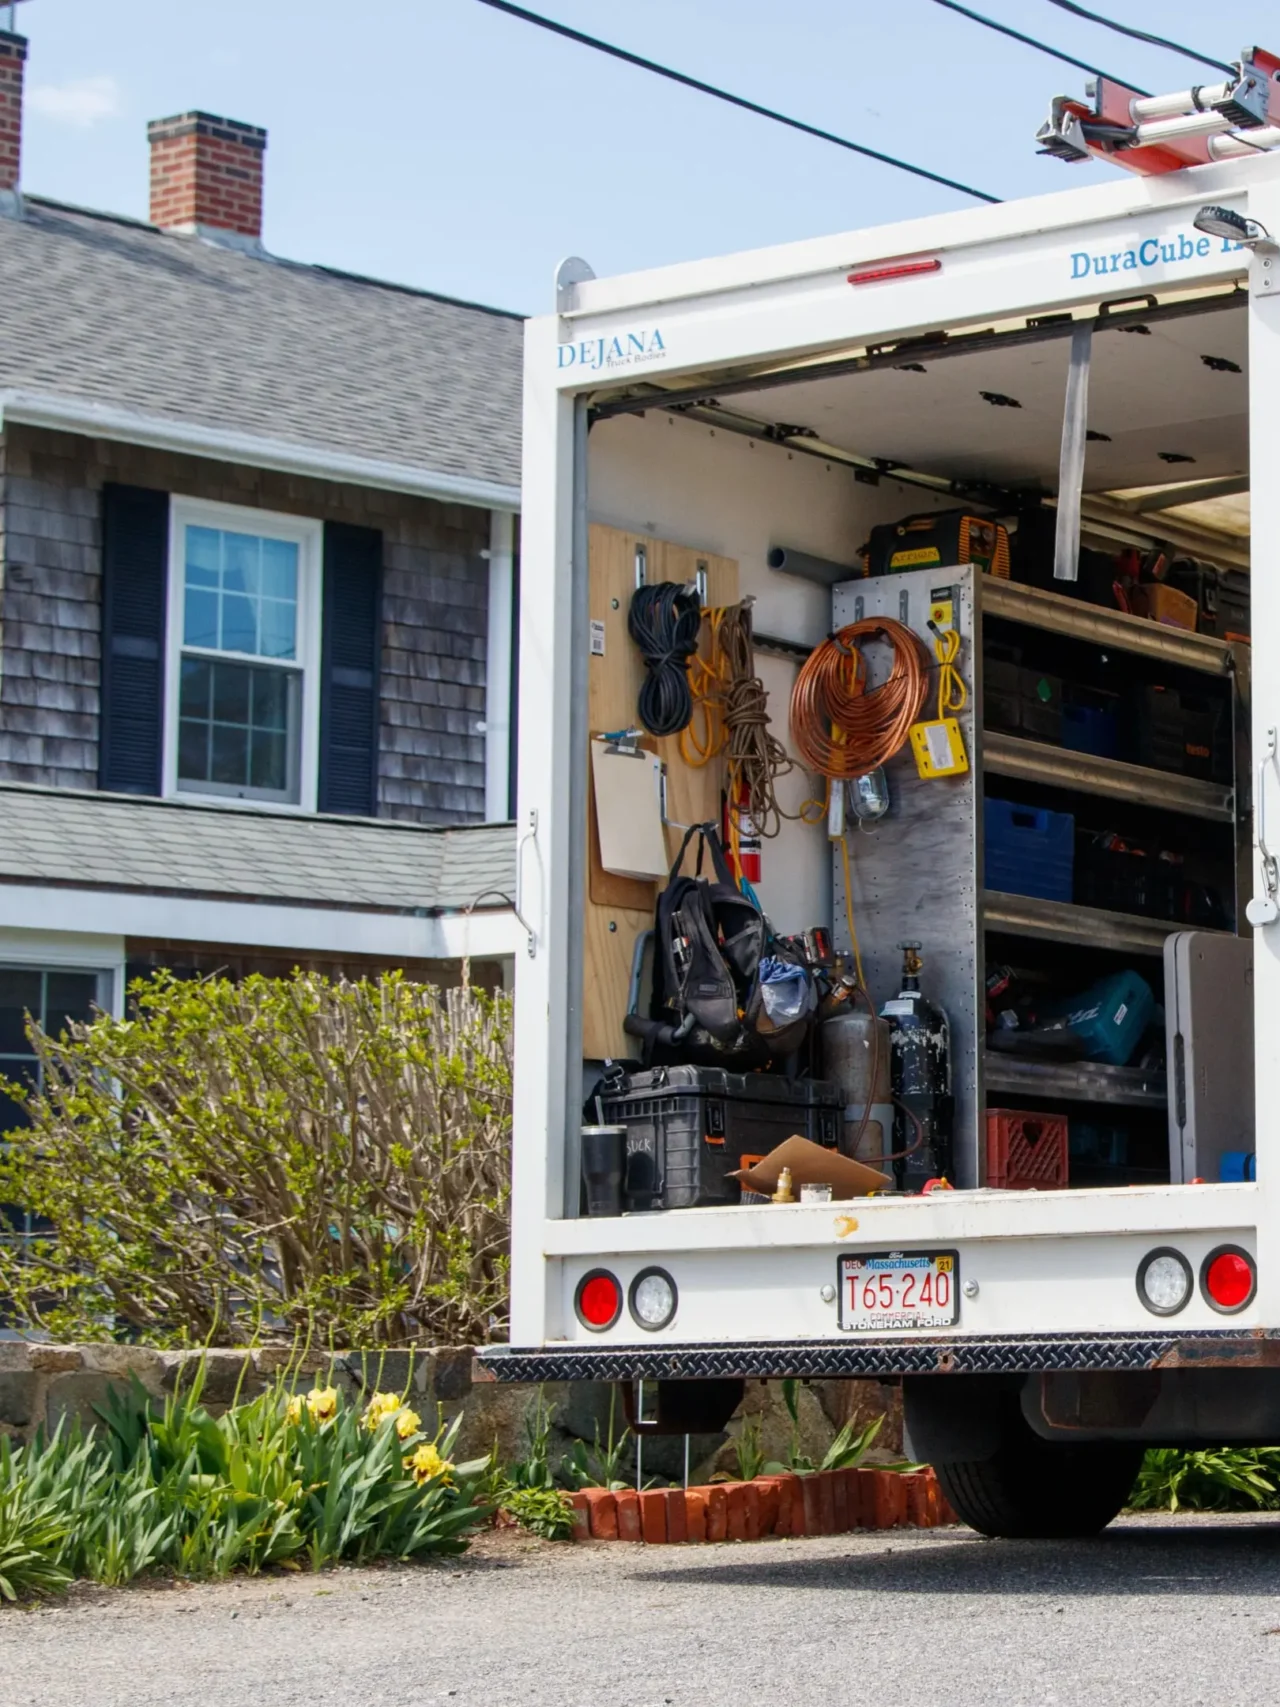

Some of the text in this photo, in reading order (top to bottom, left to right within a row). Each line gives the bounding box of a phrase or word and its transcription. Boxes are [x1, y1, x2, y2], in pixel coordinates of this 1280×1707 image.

[1070, 234, 1210, 279] DuraCube
[557, 328, 665, 370] DEJANA
[865, 1258, 931, 1270] Massachusetts
[939, 1260, 950, 1271] 21
[843, 1318, 952, 1330] STONEHAM FORD
